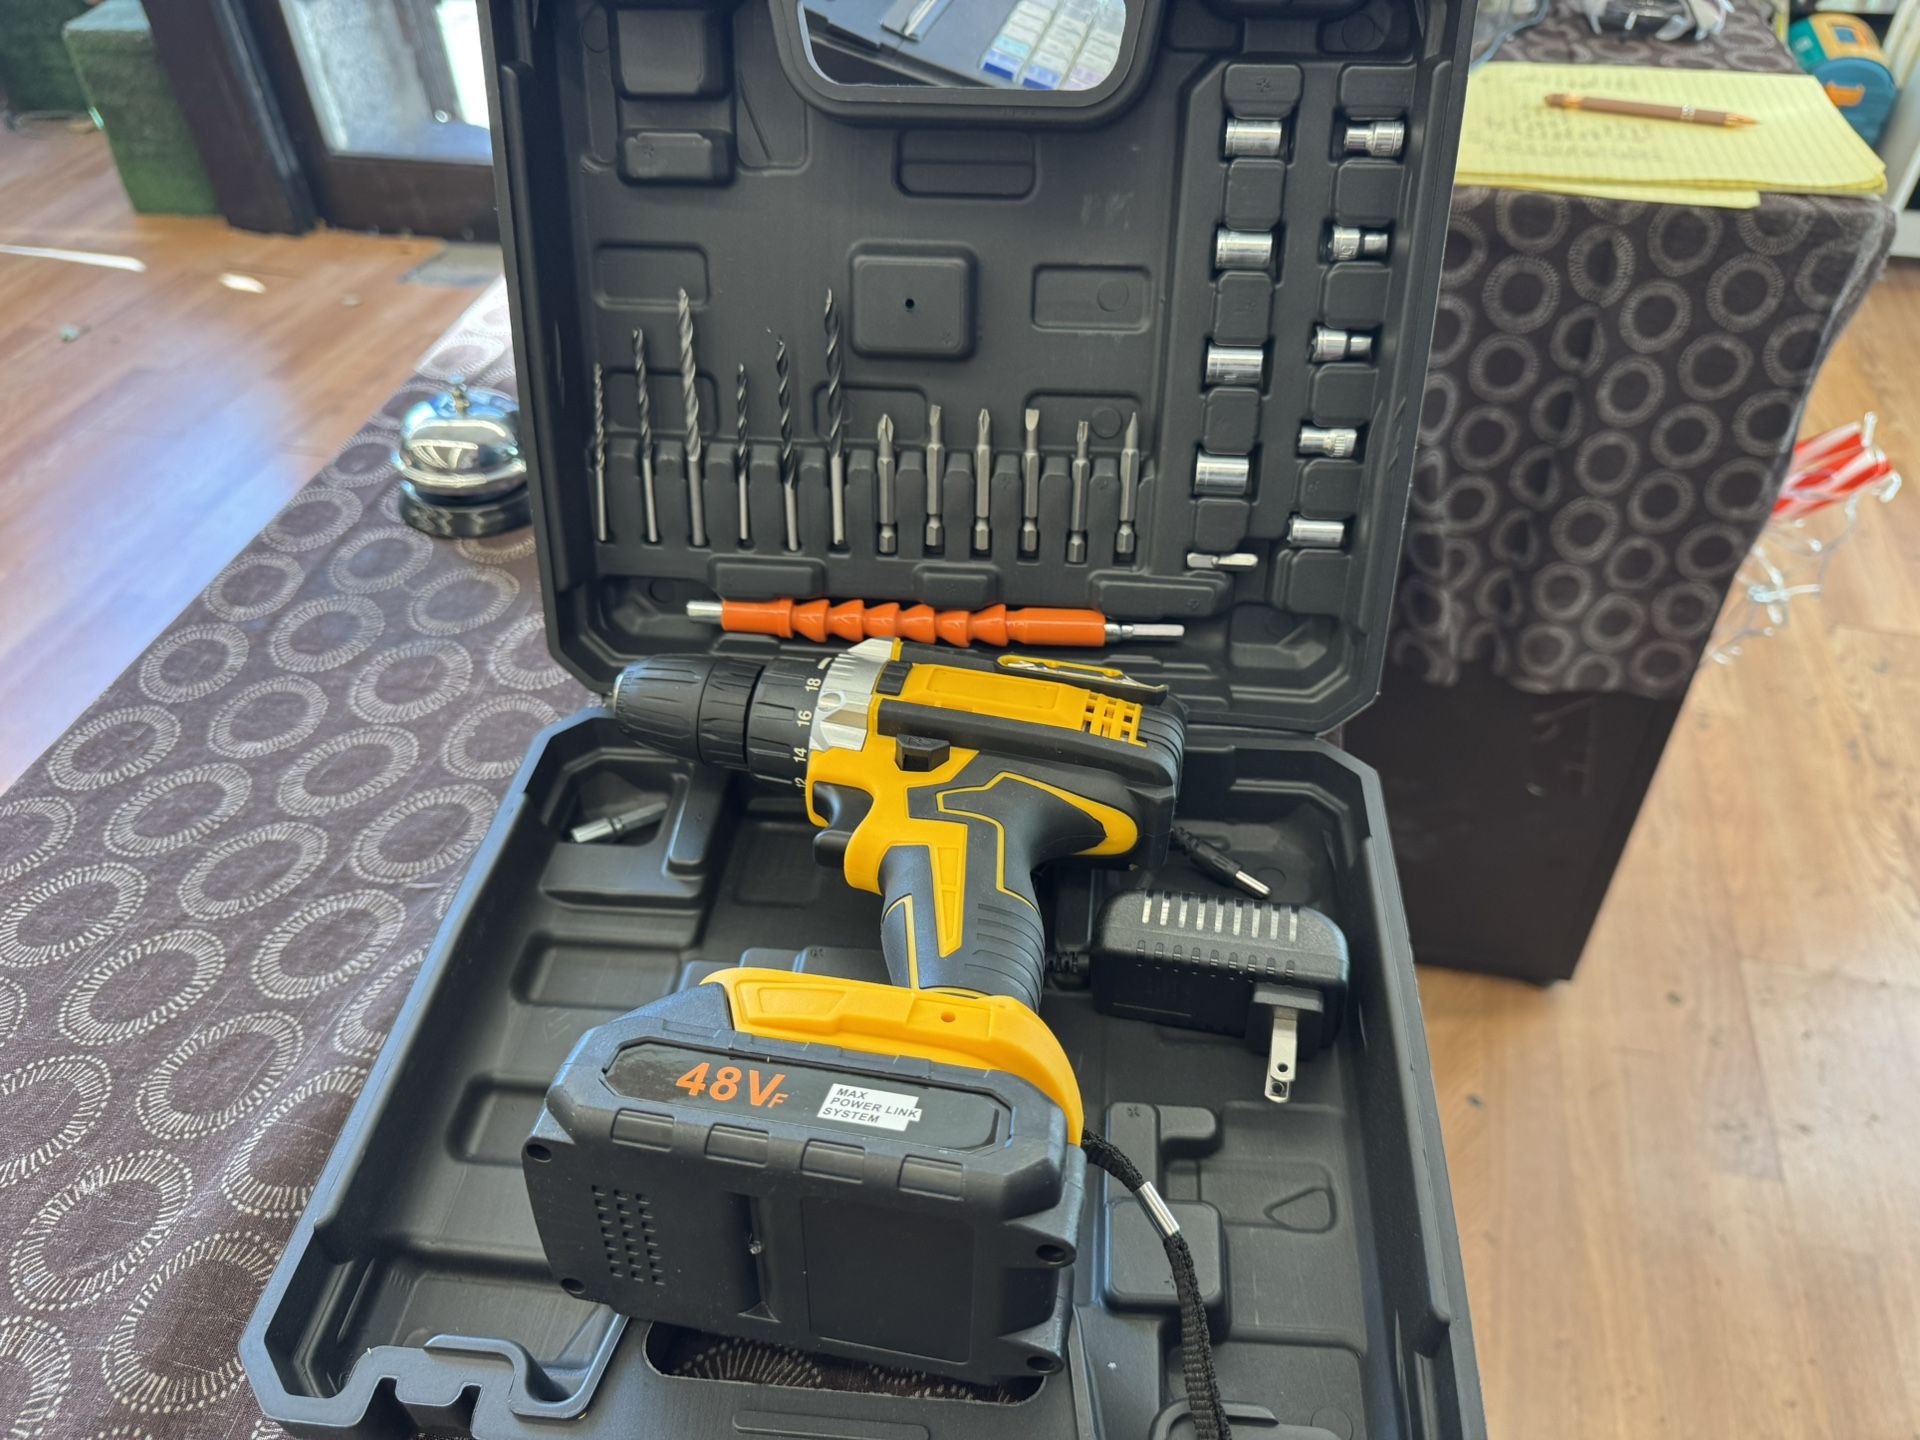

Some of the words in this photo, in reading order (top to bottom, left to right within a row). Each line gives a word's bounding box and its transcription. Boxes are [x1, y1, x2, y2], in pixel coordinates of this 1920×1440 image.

[805, 678, 821, 692] 18
[797, 710, 812, 727] 16
[793, 747, 807, 762] 14
[835, 1088, 869, 1100] MAX
[822, 1106, 881, 1124] SYSTEM
[829, 1097, 883, 1113] POWER
[885, 1105, 920, 1119] LINK
